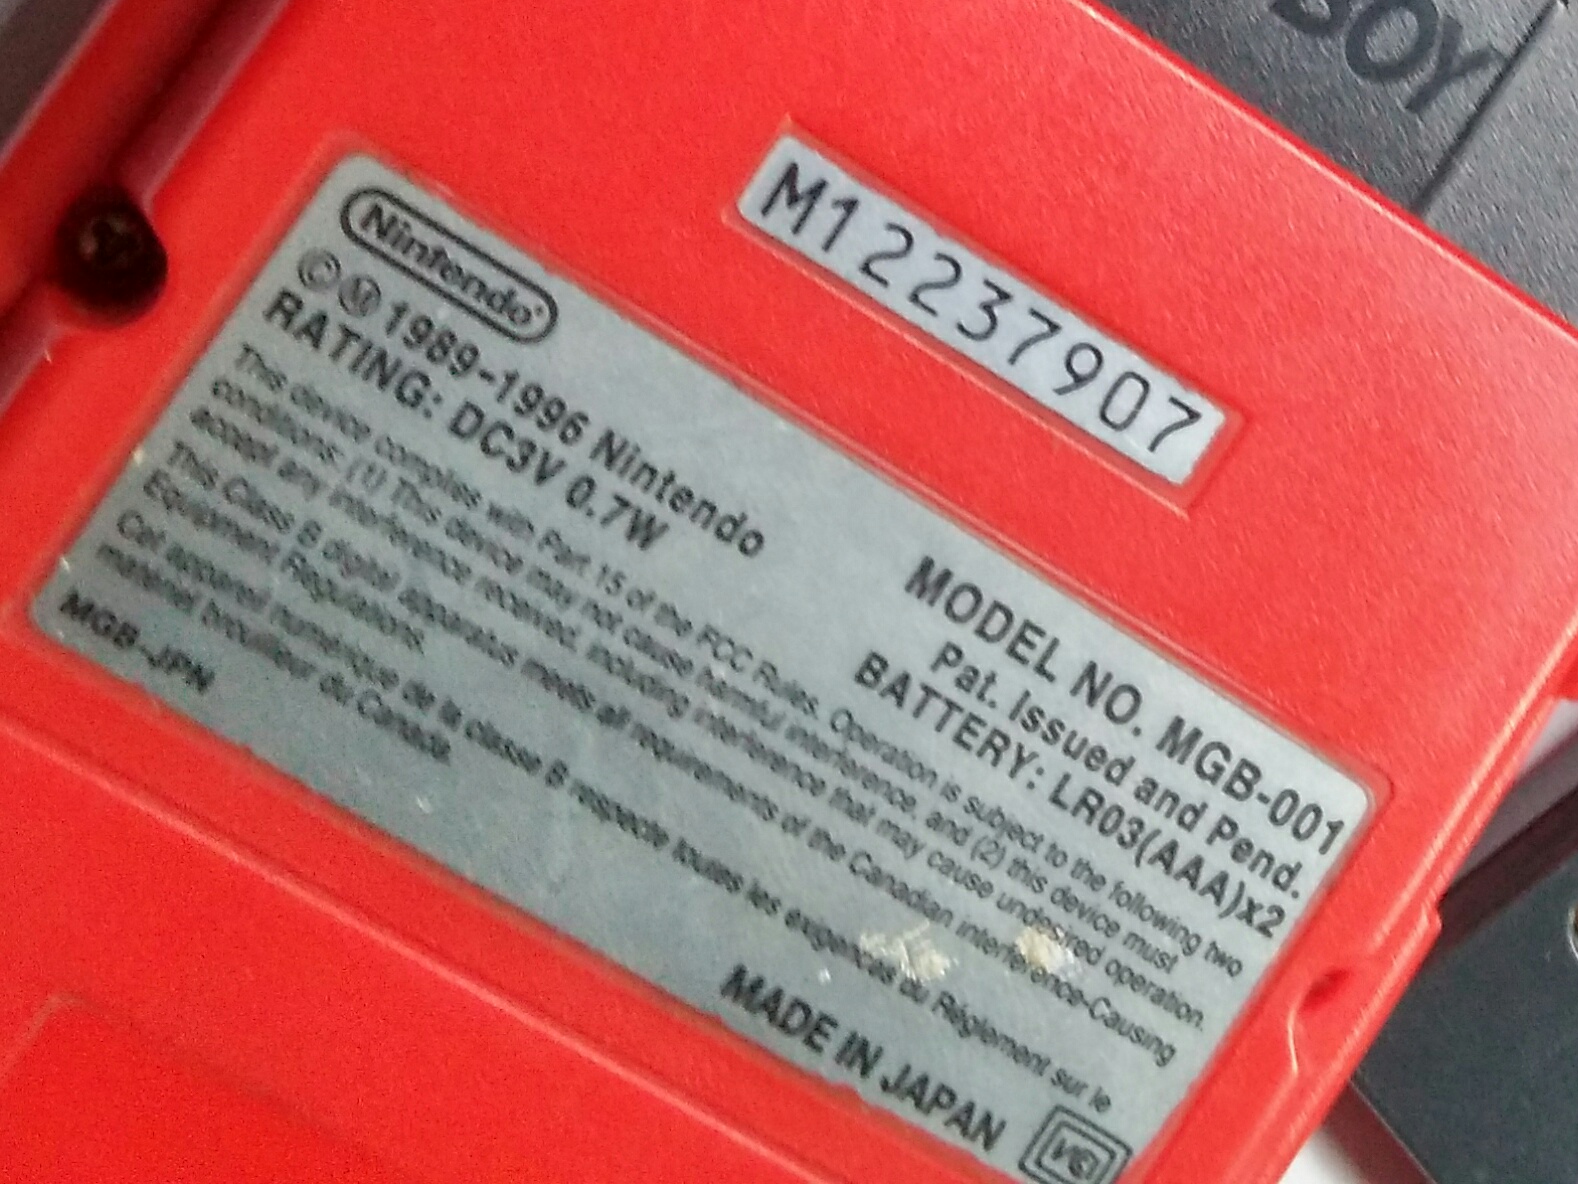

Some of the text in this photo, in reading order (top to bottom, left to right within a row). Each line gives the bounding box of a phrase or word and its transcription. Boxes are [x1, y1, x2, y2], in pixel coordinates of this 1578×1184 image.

[263, 288, 669, 550] RATING: DC3V 0.7W
[385, 301, 589, 445] 1989-1996
[589, 428, 764, 557] Nintendo
[761, 160, 1203, 457] M12237907
[58, 589, 215, 694] MGB-JPN
[166, 438, 219, 491] This
[220, 475, 295, 534] Class
[295, 518, 323, 548] B
[630, 722, 779, 822] requirements
[779, 812, 811, 838] of
[806, 826, 847, 862] the
[847, 849, 954, 928] Canadian
[234, 341, 288, 393] This
[288, 383, 372, 444] device
[536, 527, 591, 576] Part
[596, 563, 626, 596] 15
[624, 587, 657, 612] of
[653, 601, 693, 638] the
[695, 623, 753, 673] FCC
[828, 707, 938, 789] Operation
[938, 780, 962, 804] is
[961, 795, 1045, 854] subject
[1043, 841, 1068, 869] to
[1069, 856, 1107, 893] the
[1107, 879, 1202, 957] following
[1203, 939, 1243, 978] two
[343, 456, 388, 496] (1)
[390, 475, 442, 526] This
[443, 516, 524, 575] device
[525, 565, 578, 610] may
[621, 625, 694, 678] cause
[924, 809, 973, 847] and
[969, 834, 1007, 870] (2)
[1005, 856, 1048, 894] this
[1049, 885, 1121, 939] device
[1121, 930, 1179, 974] must
[904, 555, 1344, 854] MODEL NO. MGB-001
[929, 640, 1302, 899] Pat. Issued and Pend.
[401, 679, 436, 714] de
[543, 758, 569, 788] B
[744, 879, 782, 916] les
[1048, 1067, 1088, 1098] sur
[1088, 1086, 1112, 1114] le
[585, 642, 691, 720] including
[692, 707, 827, 797] interference
[827, 785, 877, 827] that
[875, 817, 926, 860] may
[925, 849, 994, 899] cause
[994, 892, 1106, 966] undesired
[1103, 957, 1204, 1030] operation.
[853, 651, 1285, 938] BATTERY: LR03(AAA)x2
[720, 963, 1006, 1151] MADE IN JAPAN
